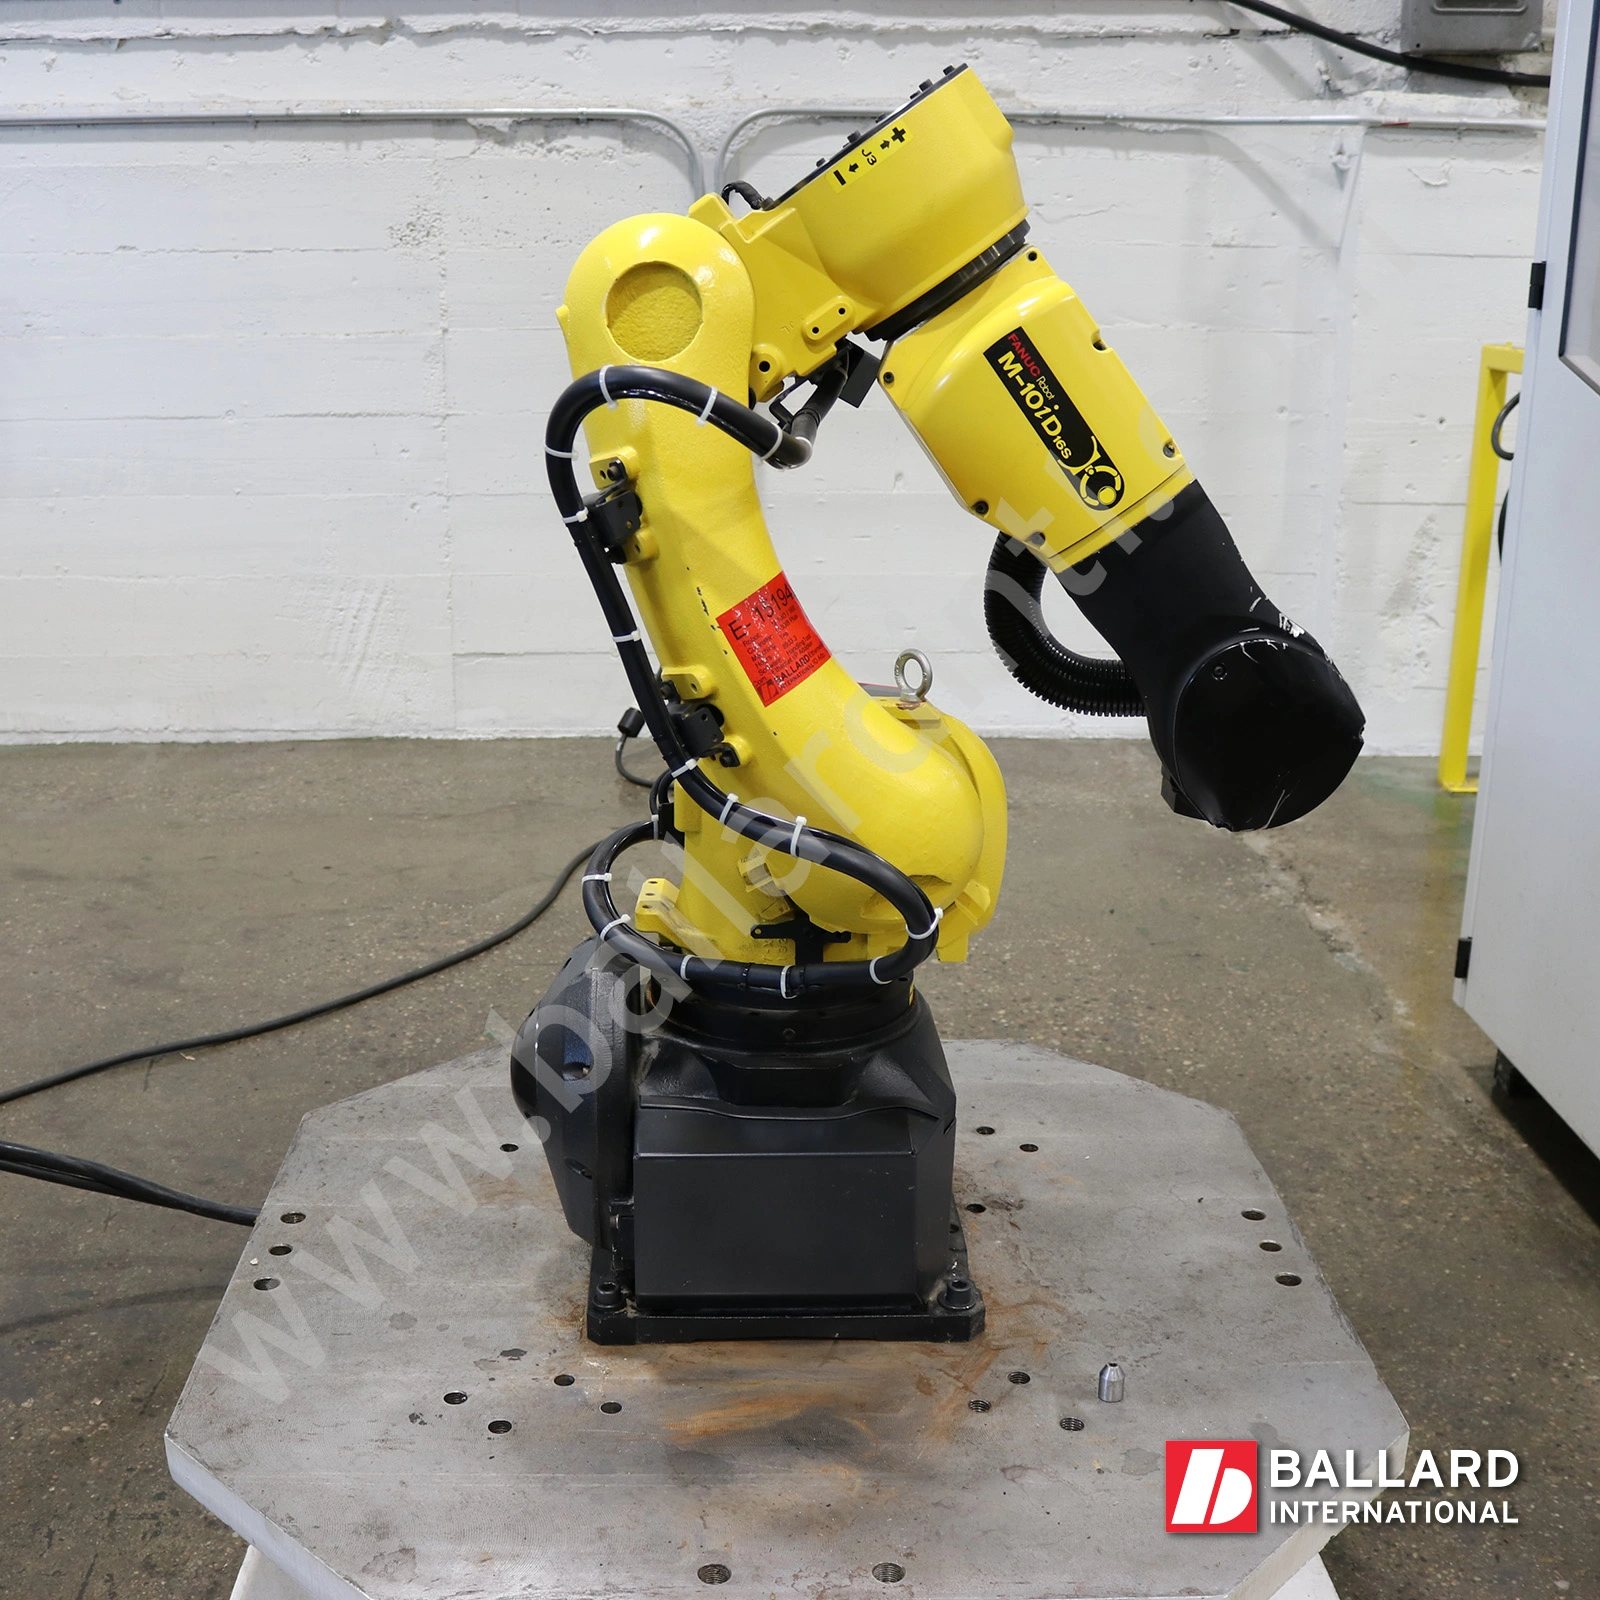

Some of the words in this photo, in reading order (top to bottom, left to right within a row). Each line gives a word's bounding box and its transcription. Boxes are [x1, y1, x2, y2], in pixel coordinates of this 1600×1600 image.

[861, 149, 878, 166] J3
[1007, 333, 1041, 377] FANUC
[1036, 376, 1055, 400] Robot
[773, 653, 811, 685] BALLARD
